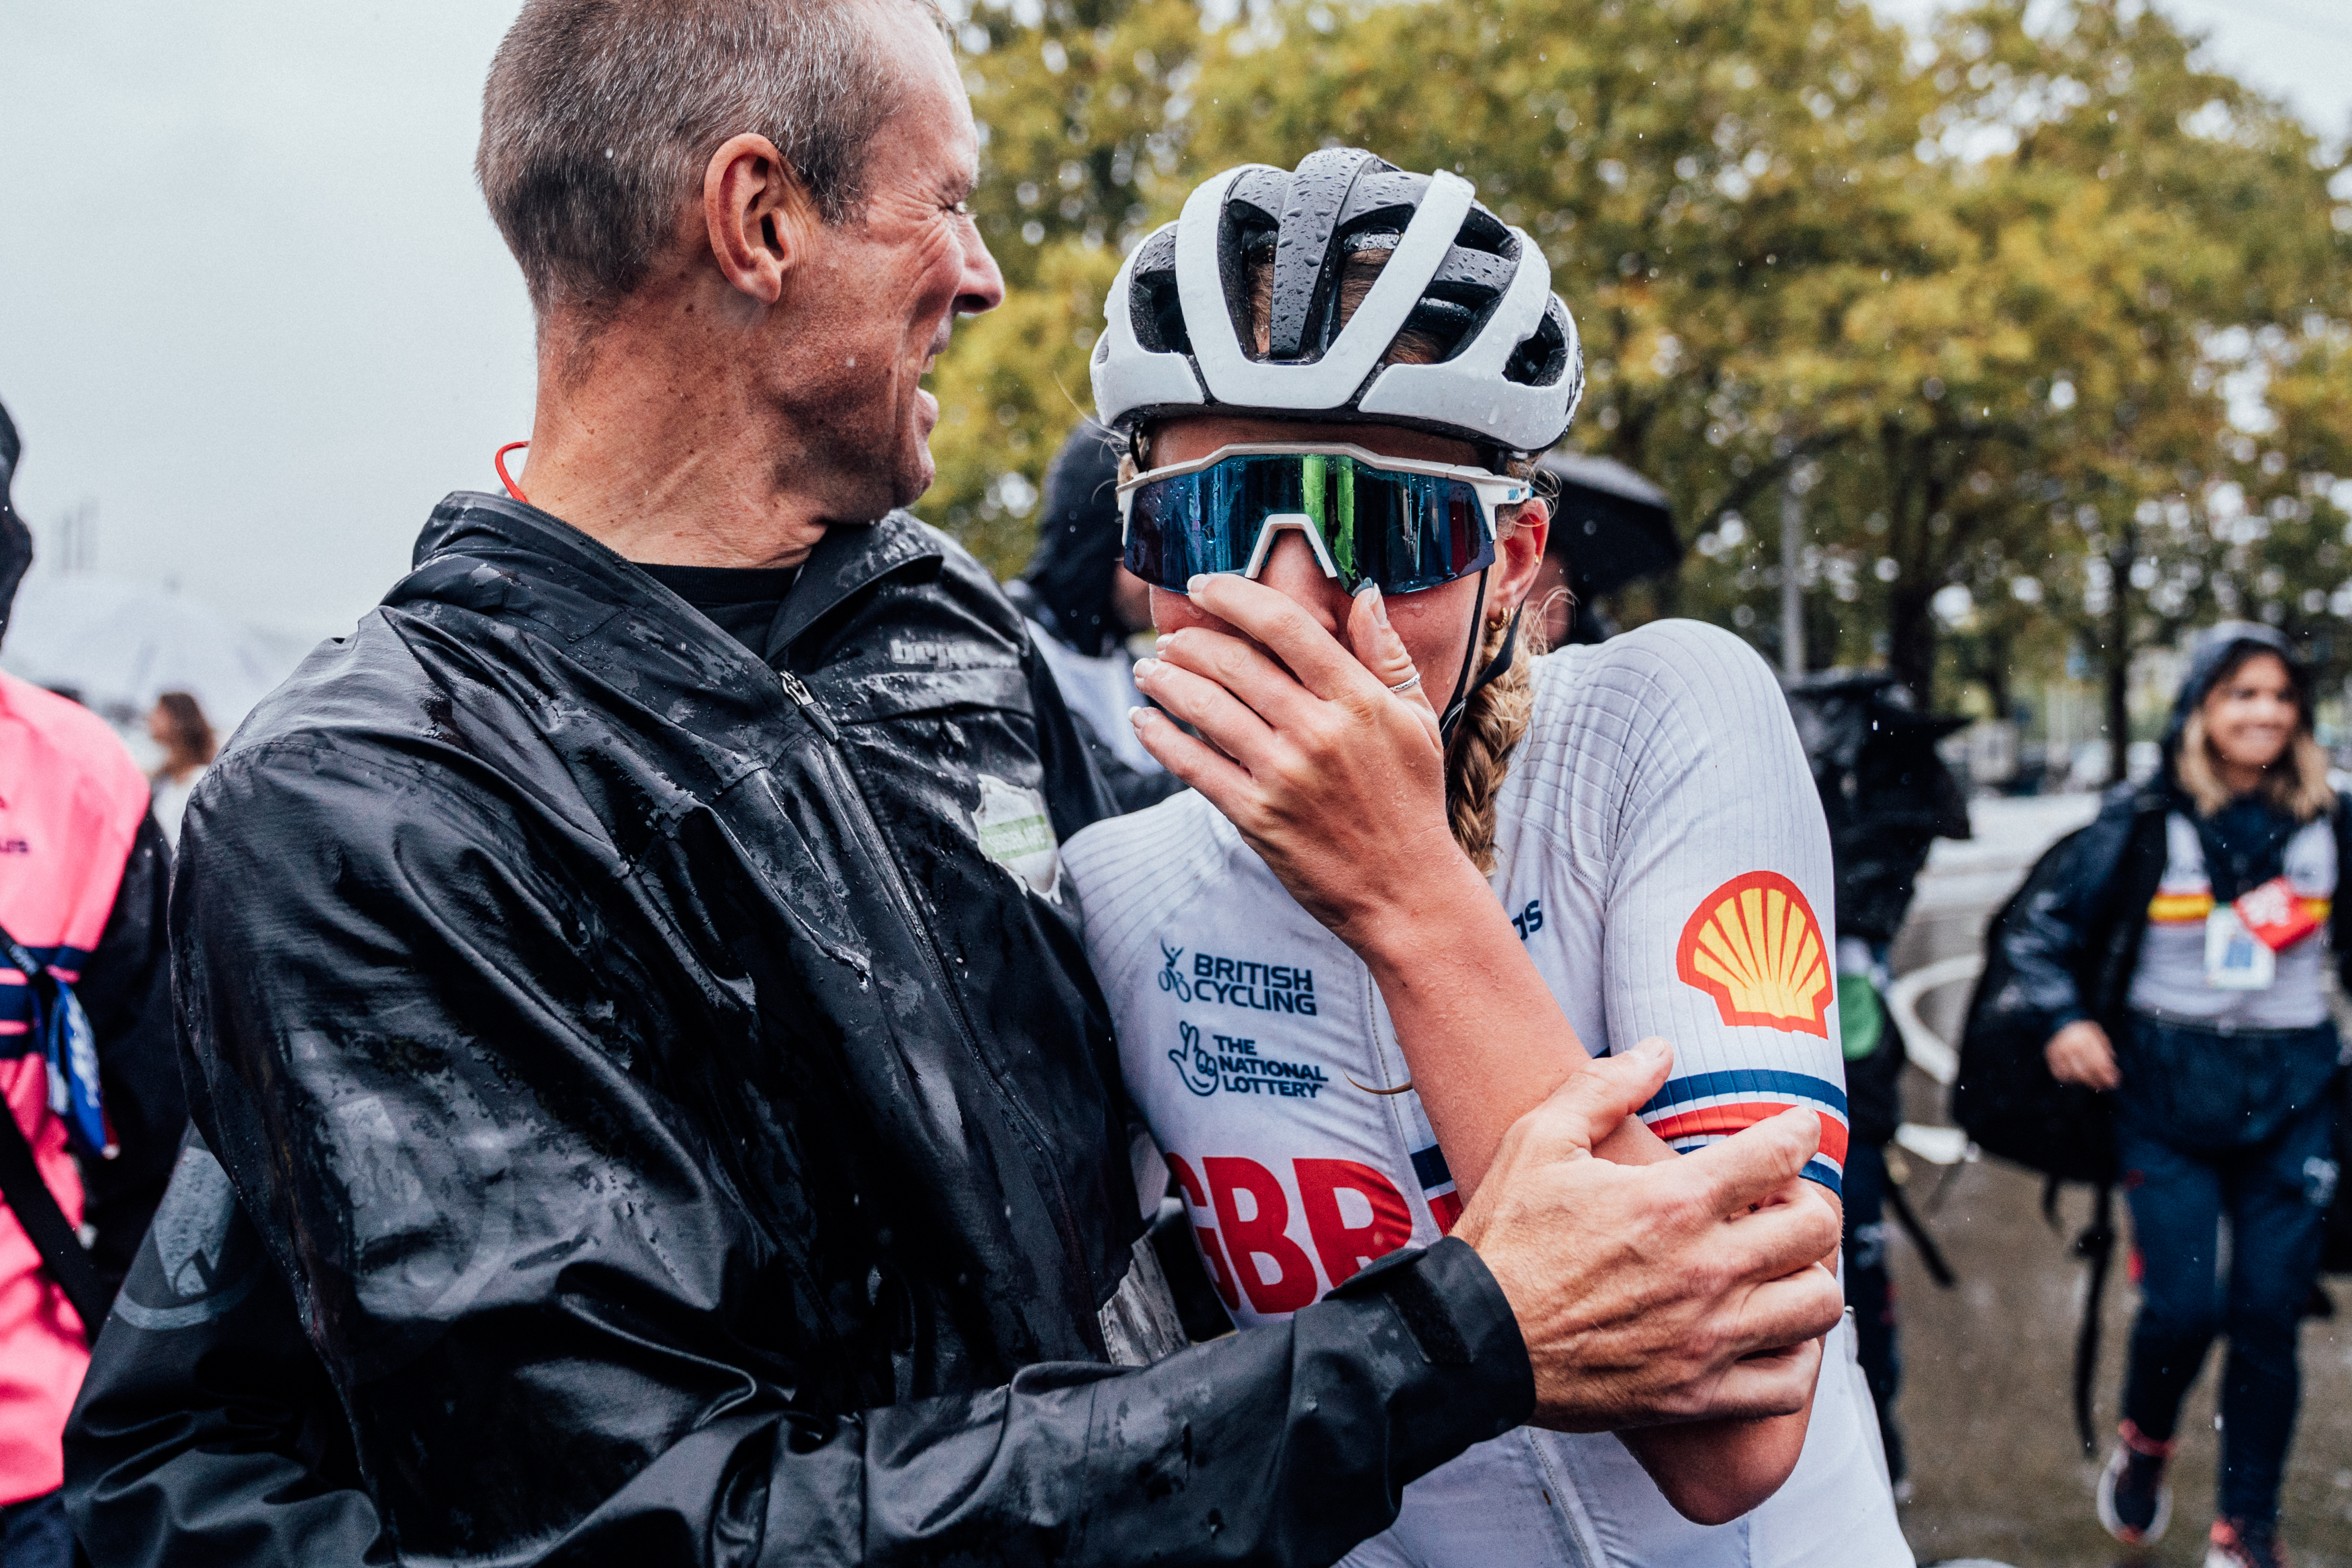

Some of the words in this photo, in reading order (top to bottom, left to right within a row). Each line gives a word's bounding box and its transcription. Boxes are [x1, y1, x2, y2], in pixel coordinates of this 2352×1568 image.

[1195, 953, 1313, 992] BRITISH
[1194, 979, 1317, 1016] CYCLING
[1213, 1034, 1257, 1055] THE
[1218, 1056, 1329, 1082] NATIONAL
[1224, 1075, 1323, 1098] LOTTERY
